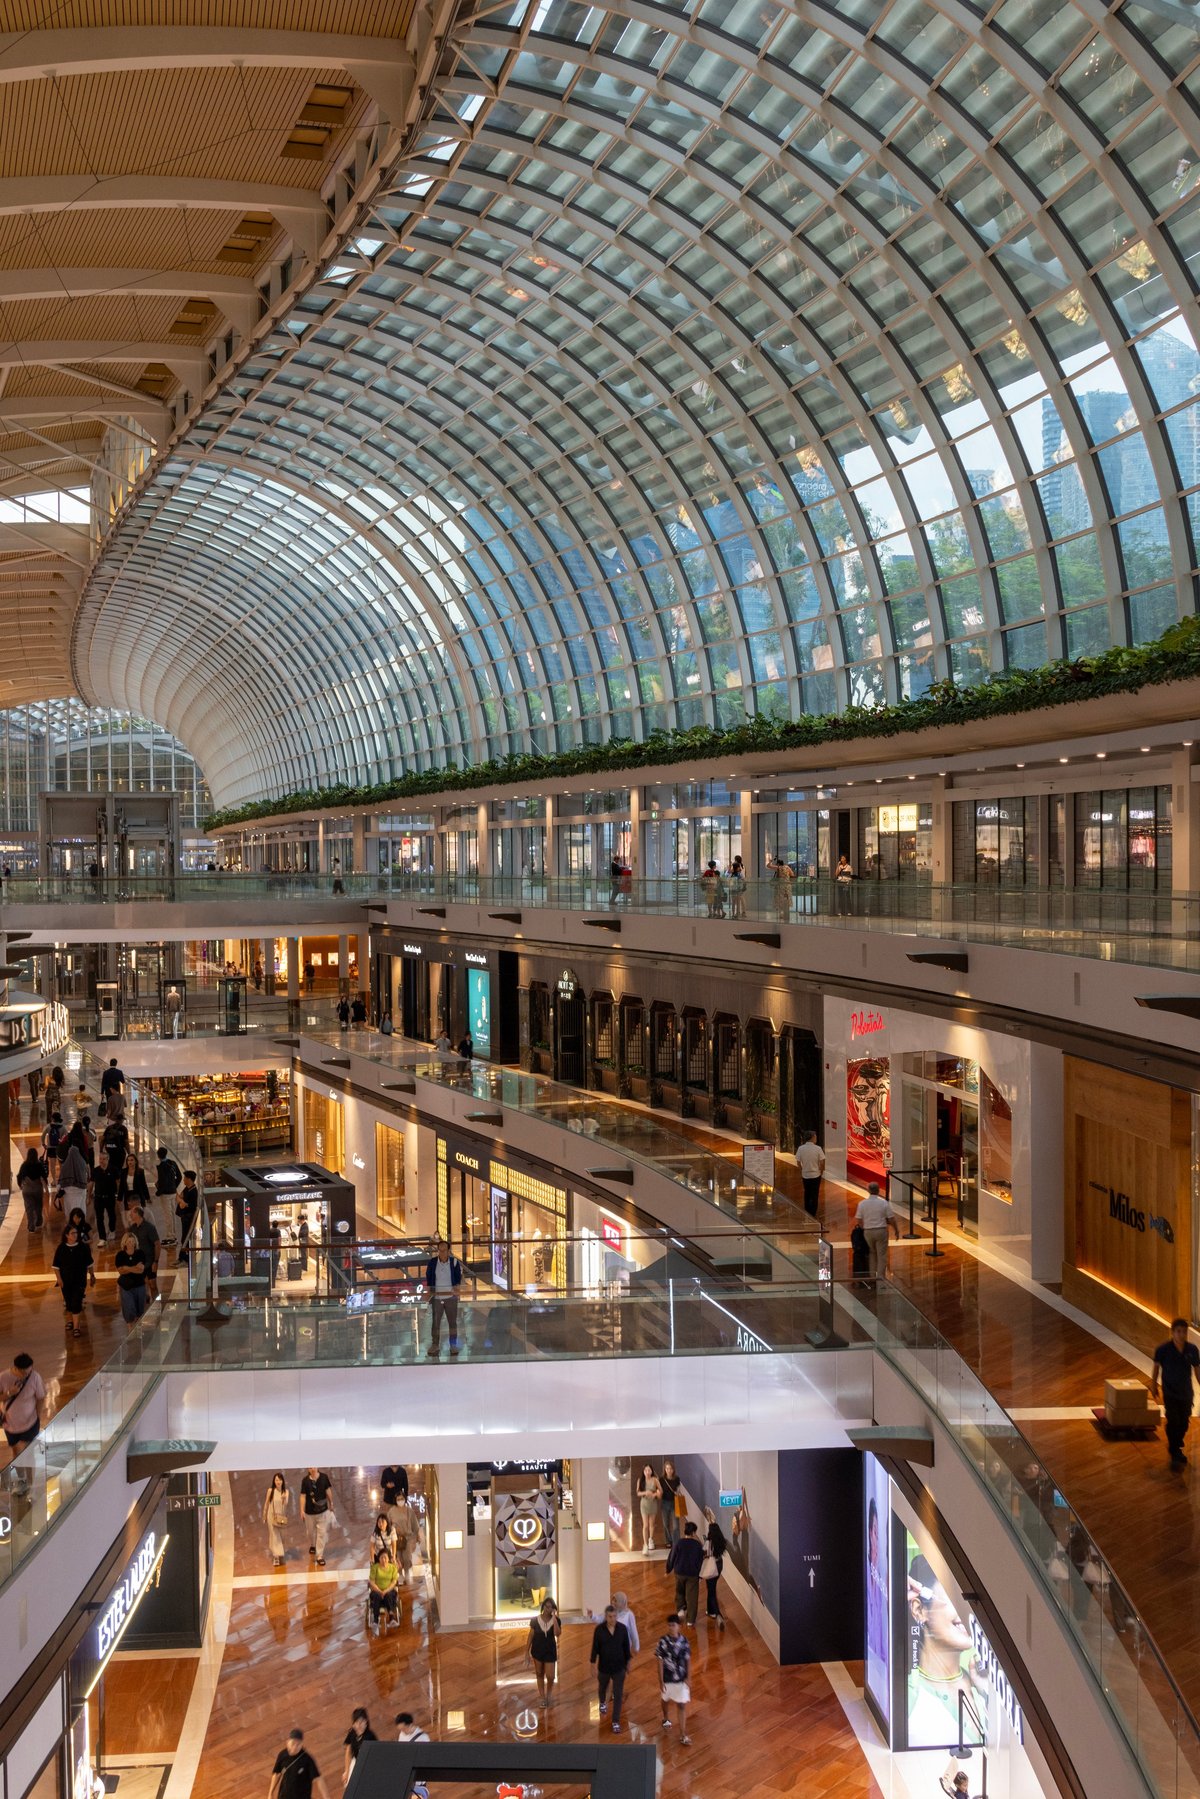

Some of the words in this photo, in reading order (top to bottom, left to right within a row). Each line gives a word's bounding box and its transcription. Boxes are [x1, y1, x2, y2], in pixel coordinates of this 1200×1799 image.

[851, 1011, 887, 1040] Roberta's
[455, 1152, 479, 1170] COACH
[1109, 1189, 1146, 1233] Milos
[205, 1496, 220, 1505] EXIT
[726, 1496, 740, 1505] EXIT
[124, 1531, 156, 1611] LAUDER
[968, 1612, 1025, 1746] SEPHORA
